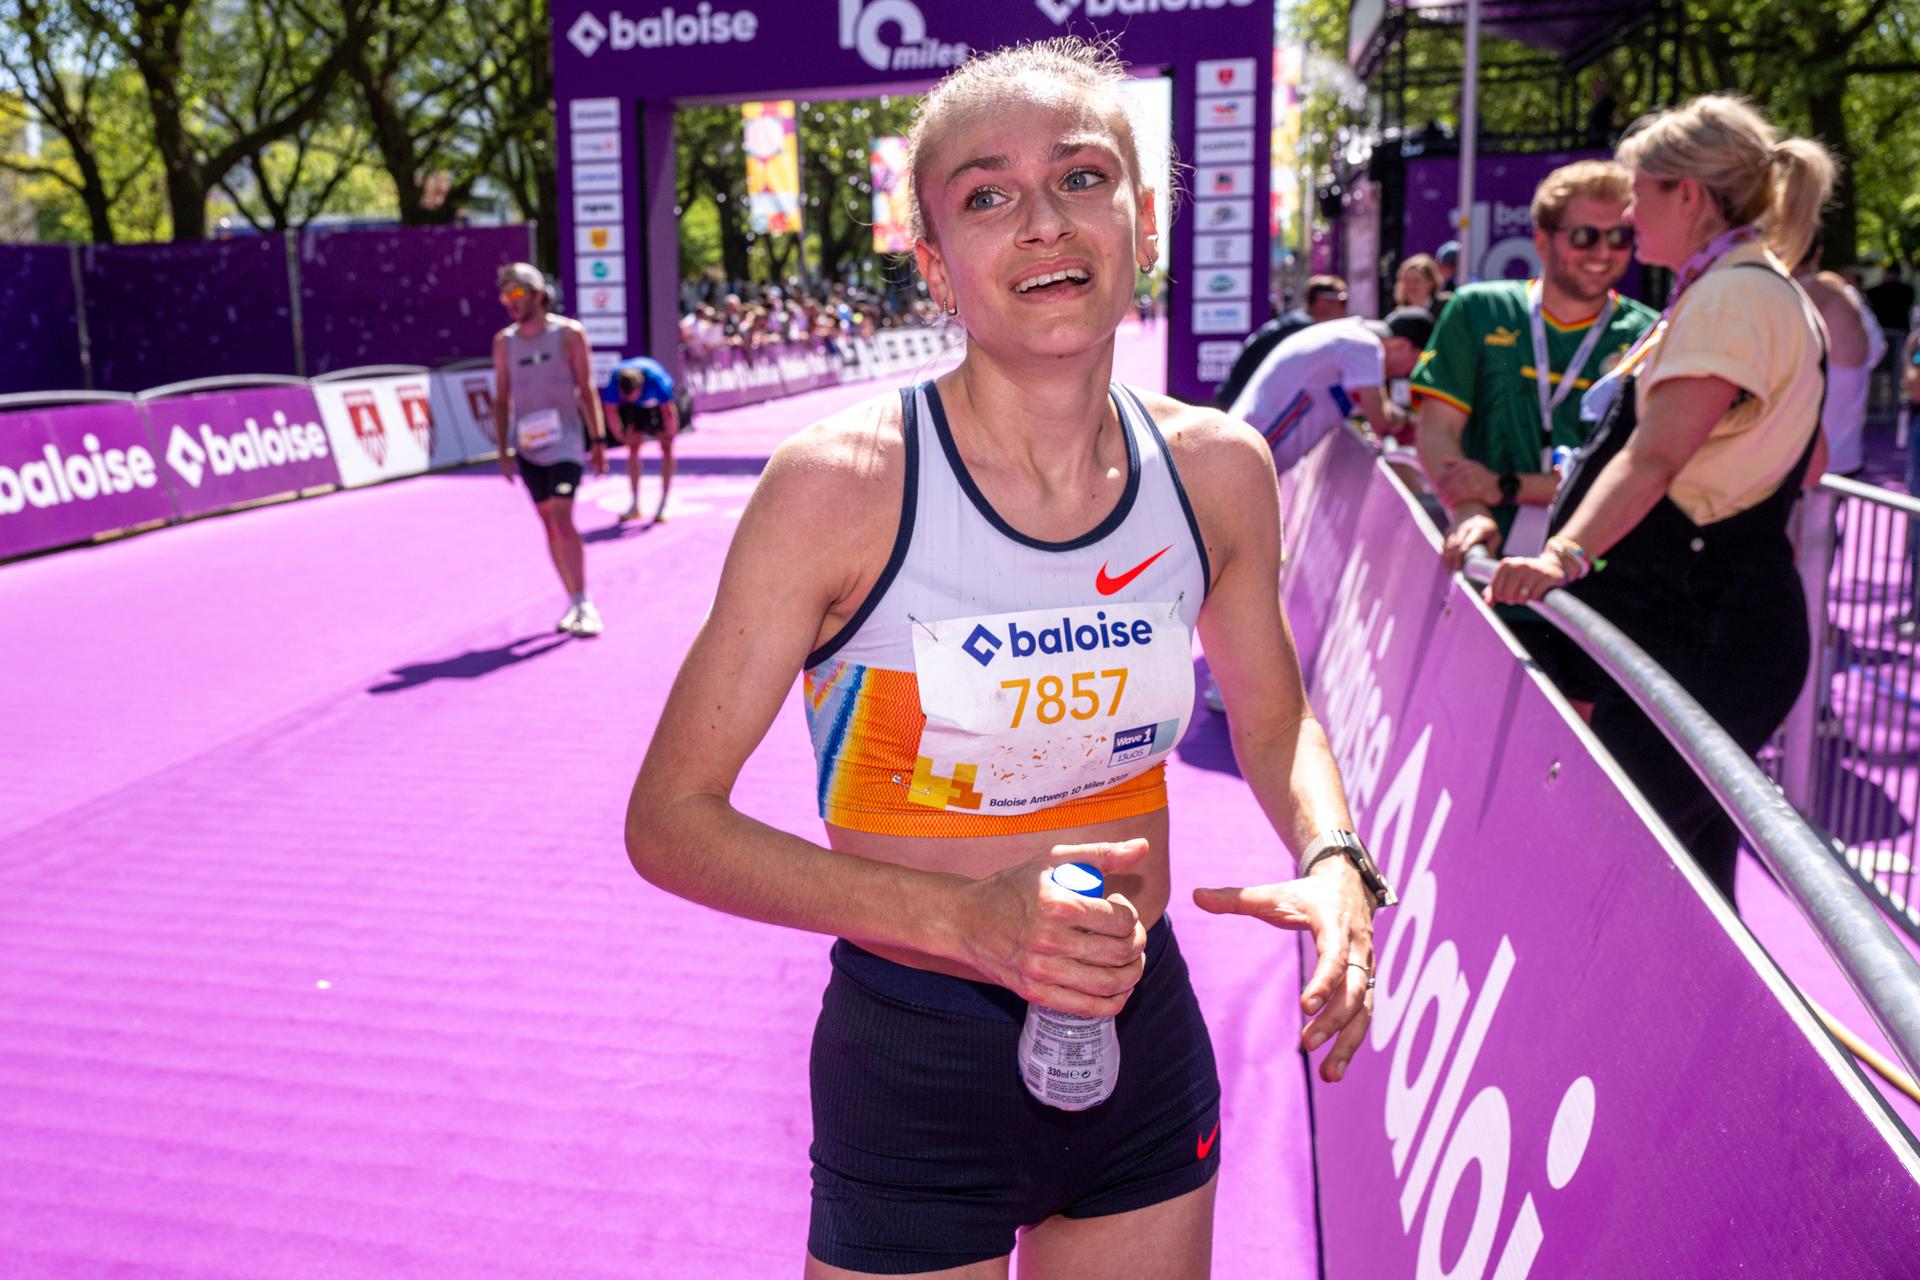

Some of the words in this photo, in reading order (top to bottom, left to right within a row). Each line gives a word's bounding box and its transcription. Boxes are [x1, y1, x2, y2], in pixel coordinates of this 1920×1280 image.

[609, 2, 758, 50] baloise
[891, 38, 968, 70] miles
[199, 410, 329, 476] baloise
[1008, 611, 1153, 658] baloise
[1000, 668, 1128, 728] 7857
[1116, 734, 1142, 747] Wave
[1143, 728, 1152, 743] 1
[989, 798, 1027, 807] Baloise
[1030, 791, 1068, 804] Antwerp
[1071, 786, 1081, 795] 10
[1083, 780, 1104, 791] Miles
[1047, 1066, 1069, 1079] 330ml
